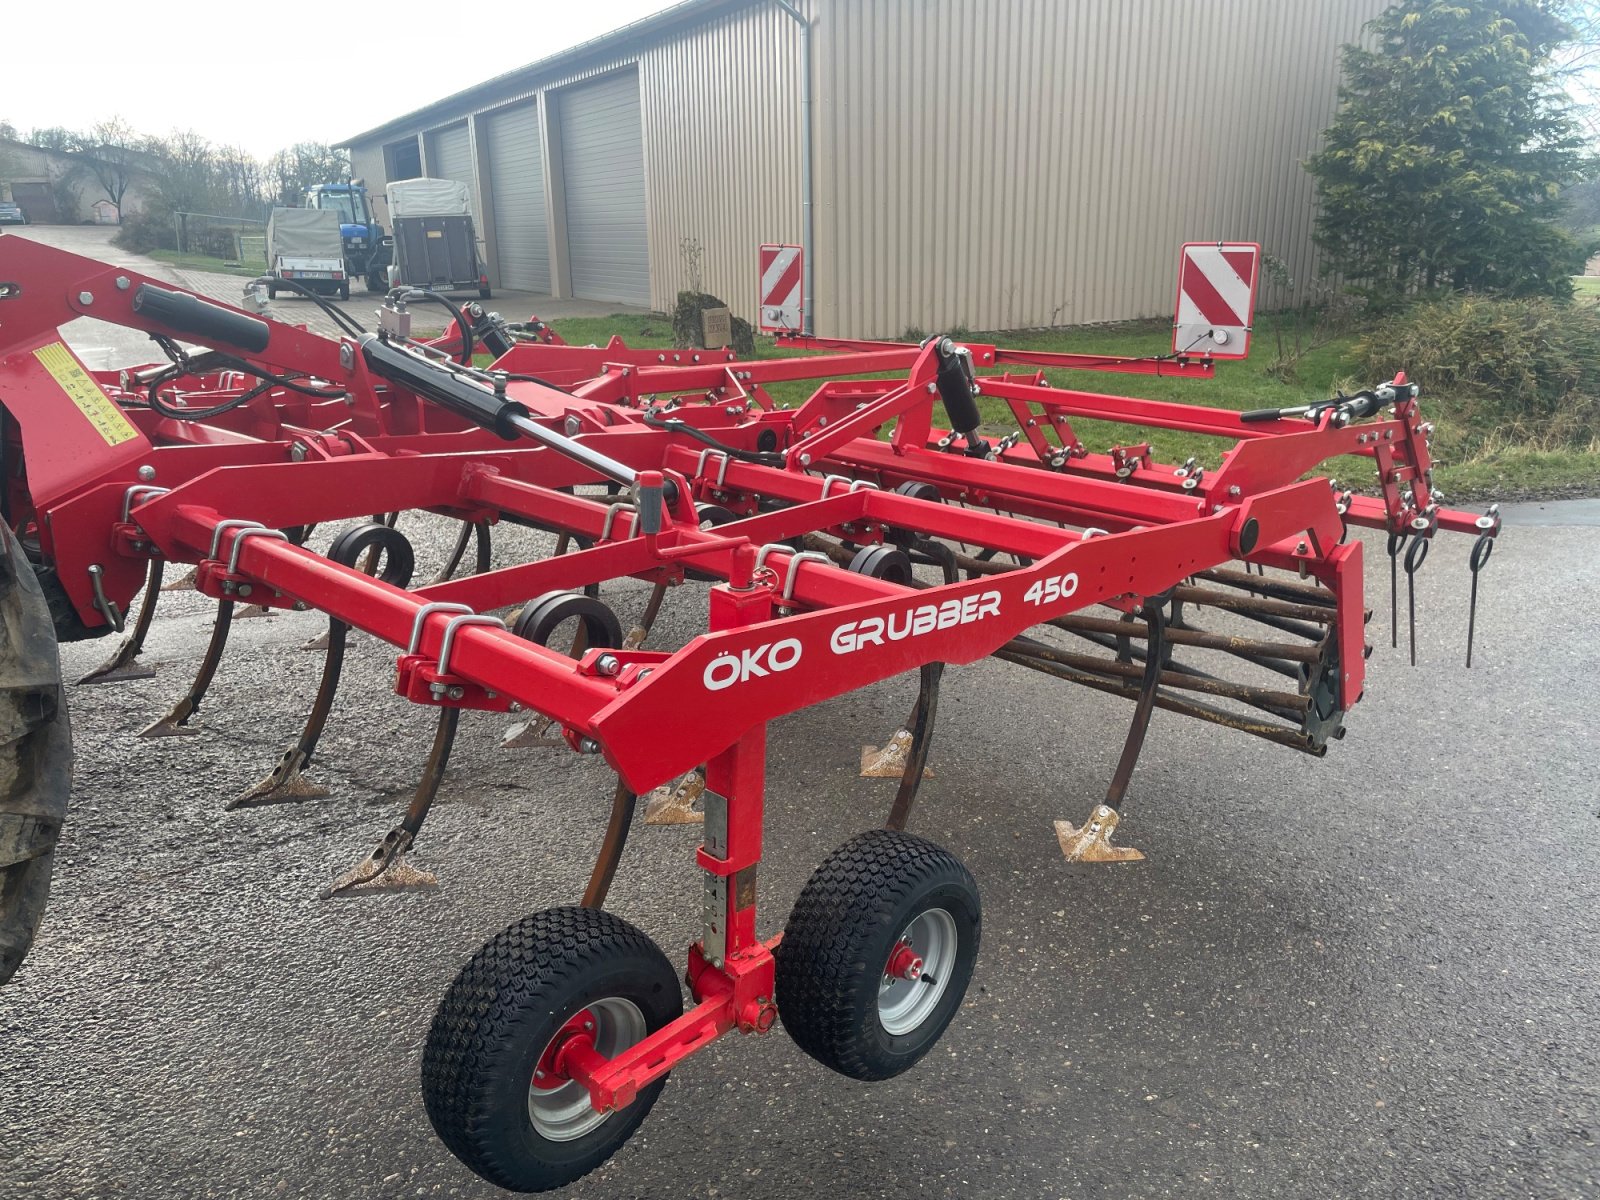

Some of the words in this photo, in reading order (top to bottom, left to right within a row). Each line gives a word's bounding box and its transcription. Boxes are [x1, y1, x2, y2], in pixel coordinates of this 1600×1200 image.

[703, 637, 803, 691] ÖKO
[830, 590, 1002, 655] GRUBBER
[1023, 572, 1079, 606] 450
[711, 889, 717, 901] 4
[711, 905, 717, 918] 5
[711, 922, 717, 934] 6
